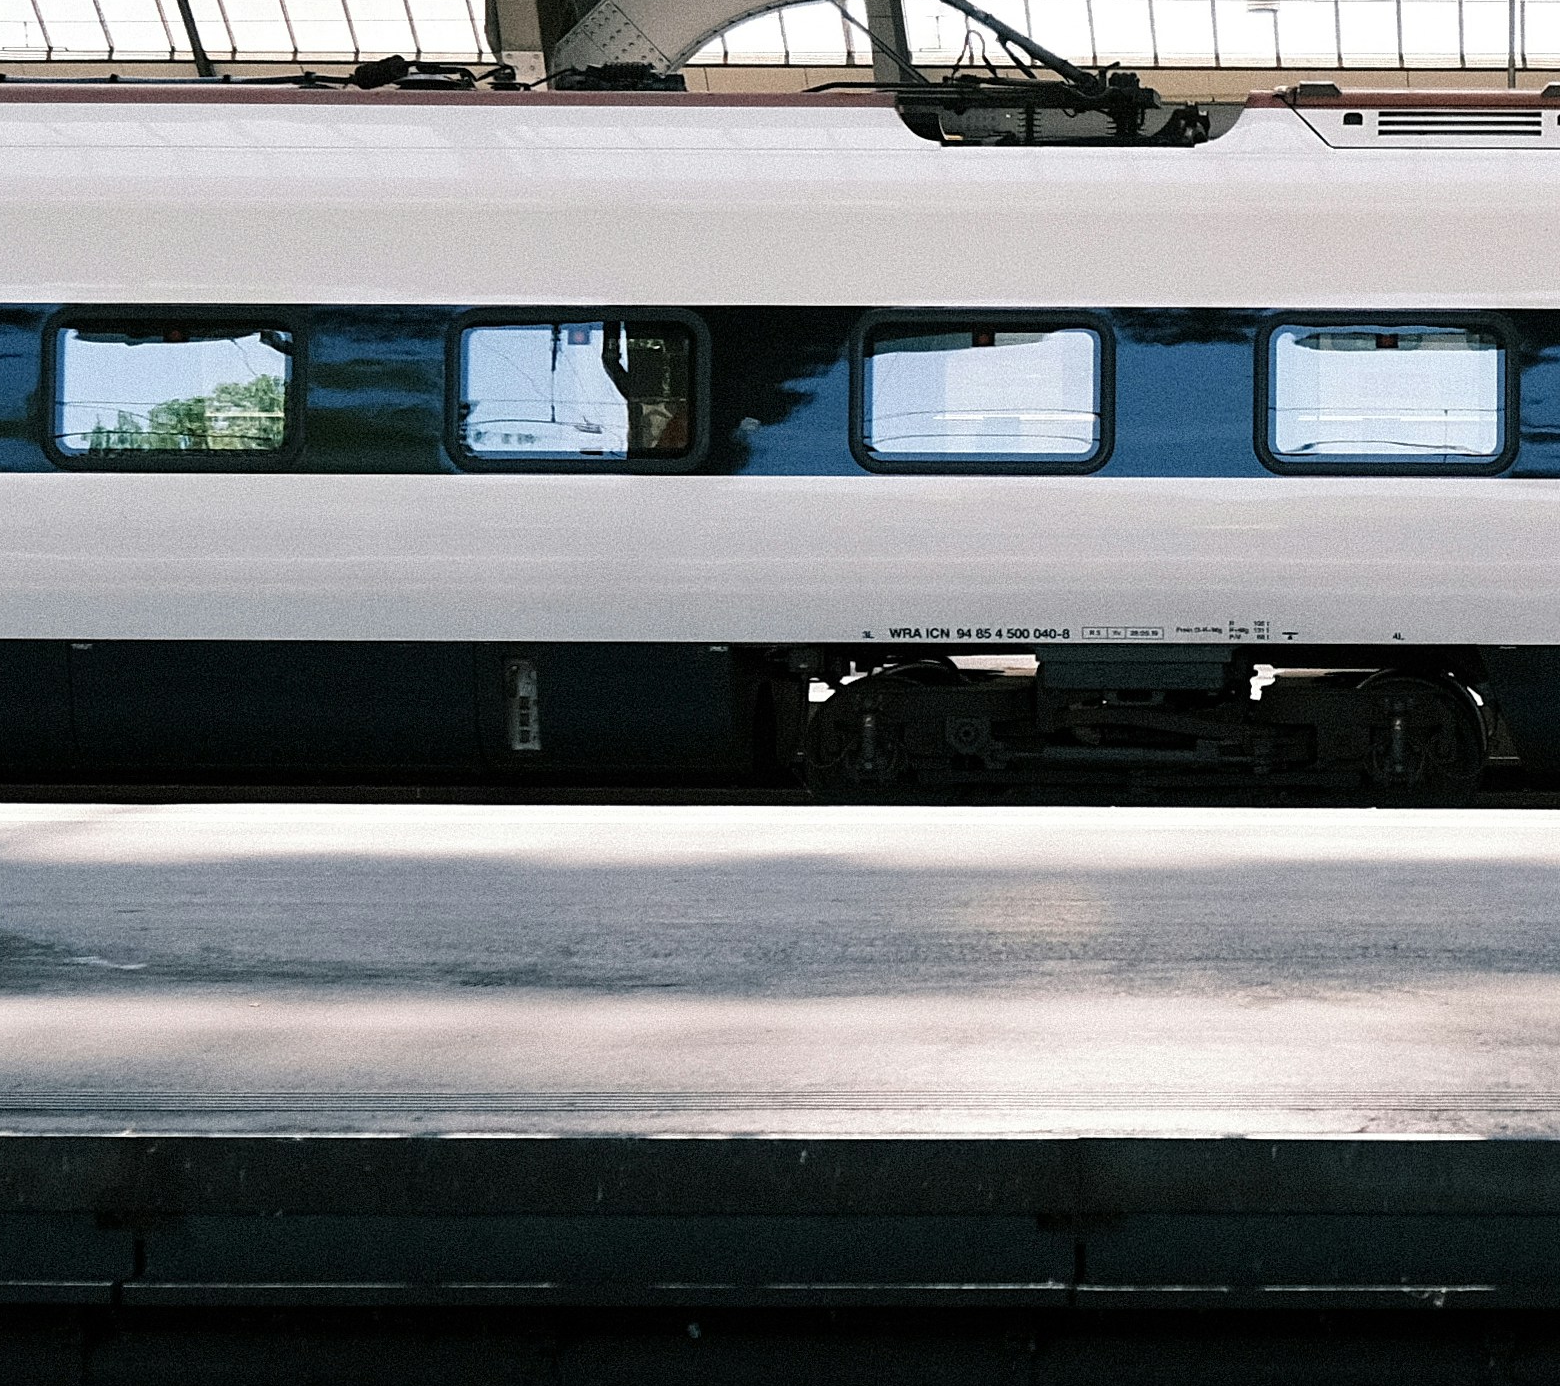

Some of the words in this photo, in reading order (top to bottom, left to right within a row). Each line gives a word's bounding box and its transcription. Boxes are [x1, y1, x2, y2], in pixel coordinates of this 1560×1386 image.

[888, 627, 923, 639] WRA
[926, 627, 951, 639] ICN
[956, 628, 972, 639] 94
[976, 628, 991, 639] 85
[995, 628, 1003, 639] 4
[1006, 628, 1030, 639] 500
[1033, 628, 1070, 639] 040-8
